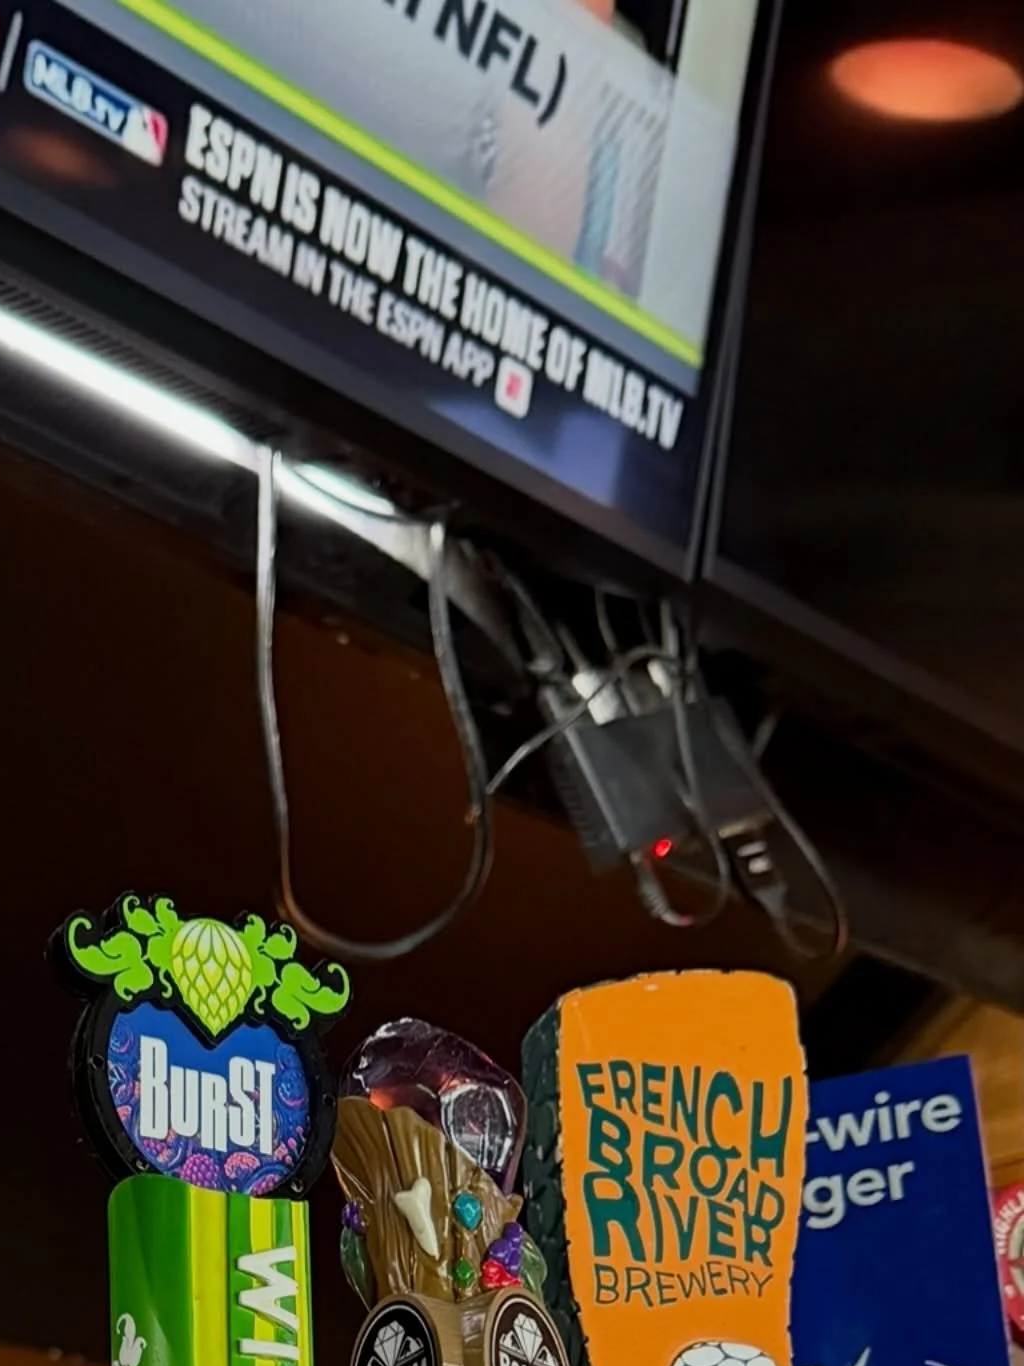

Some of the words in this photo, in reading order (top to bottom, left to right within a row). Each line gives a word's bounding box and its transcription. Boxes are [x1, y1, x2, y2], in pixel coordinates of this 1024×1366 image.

[179, 174, 294, 278] STREAM
[292, 241, 327, 297] IN
[329, 259, 376, 325] THE
[376, 290, 445, 364] ESPN
[442, 331, 495, 388] APP
[185, 103, 283, 212] ESPN
[280, 163, 320, 234] IS
[319, 186, 403, 283] NOW
[403, 236, 463, 320] THE
[460, 273, 549, 371] HOME
[545, 326, 588, 391] OF
[582, 348, 684, 450] MLB.TV
[576, 1059, 793, 1178] FRENCH
[588, 1103, 785, 1232] BROAD
[583, 1170, 774, 1268] RIVER
[594, 1261, 774, 1307] BREWERY
